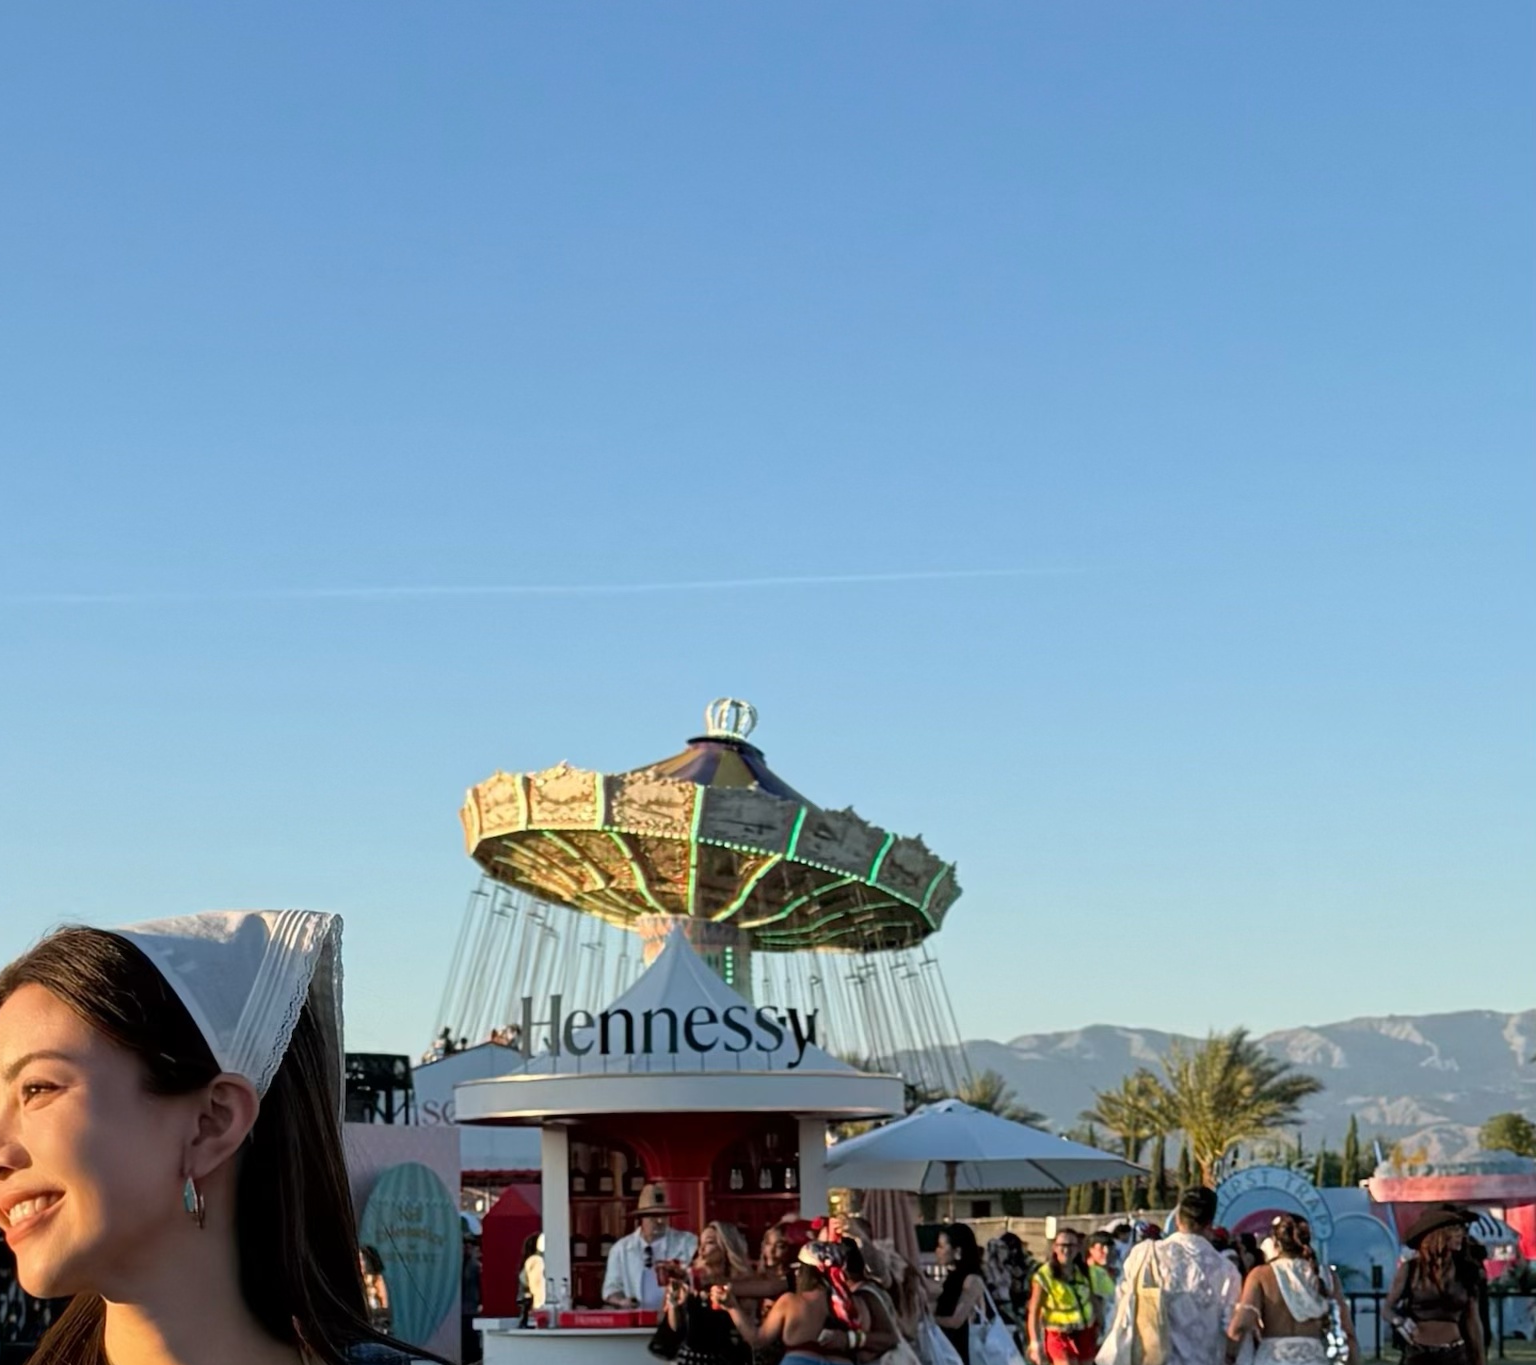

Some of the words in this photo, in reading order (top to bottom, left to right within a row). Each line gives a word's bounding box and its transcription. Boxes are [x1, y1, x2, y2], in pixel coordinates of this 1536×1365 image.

[521, 994, 819, 1069] Hennessy
[1217, 1170, 1270, 1211] IRST
[1285, 1174, 1328, 1226] TRAP
